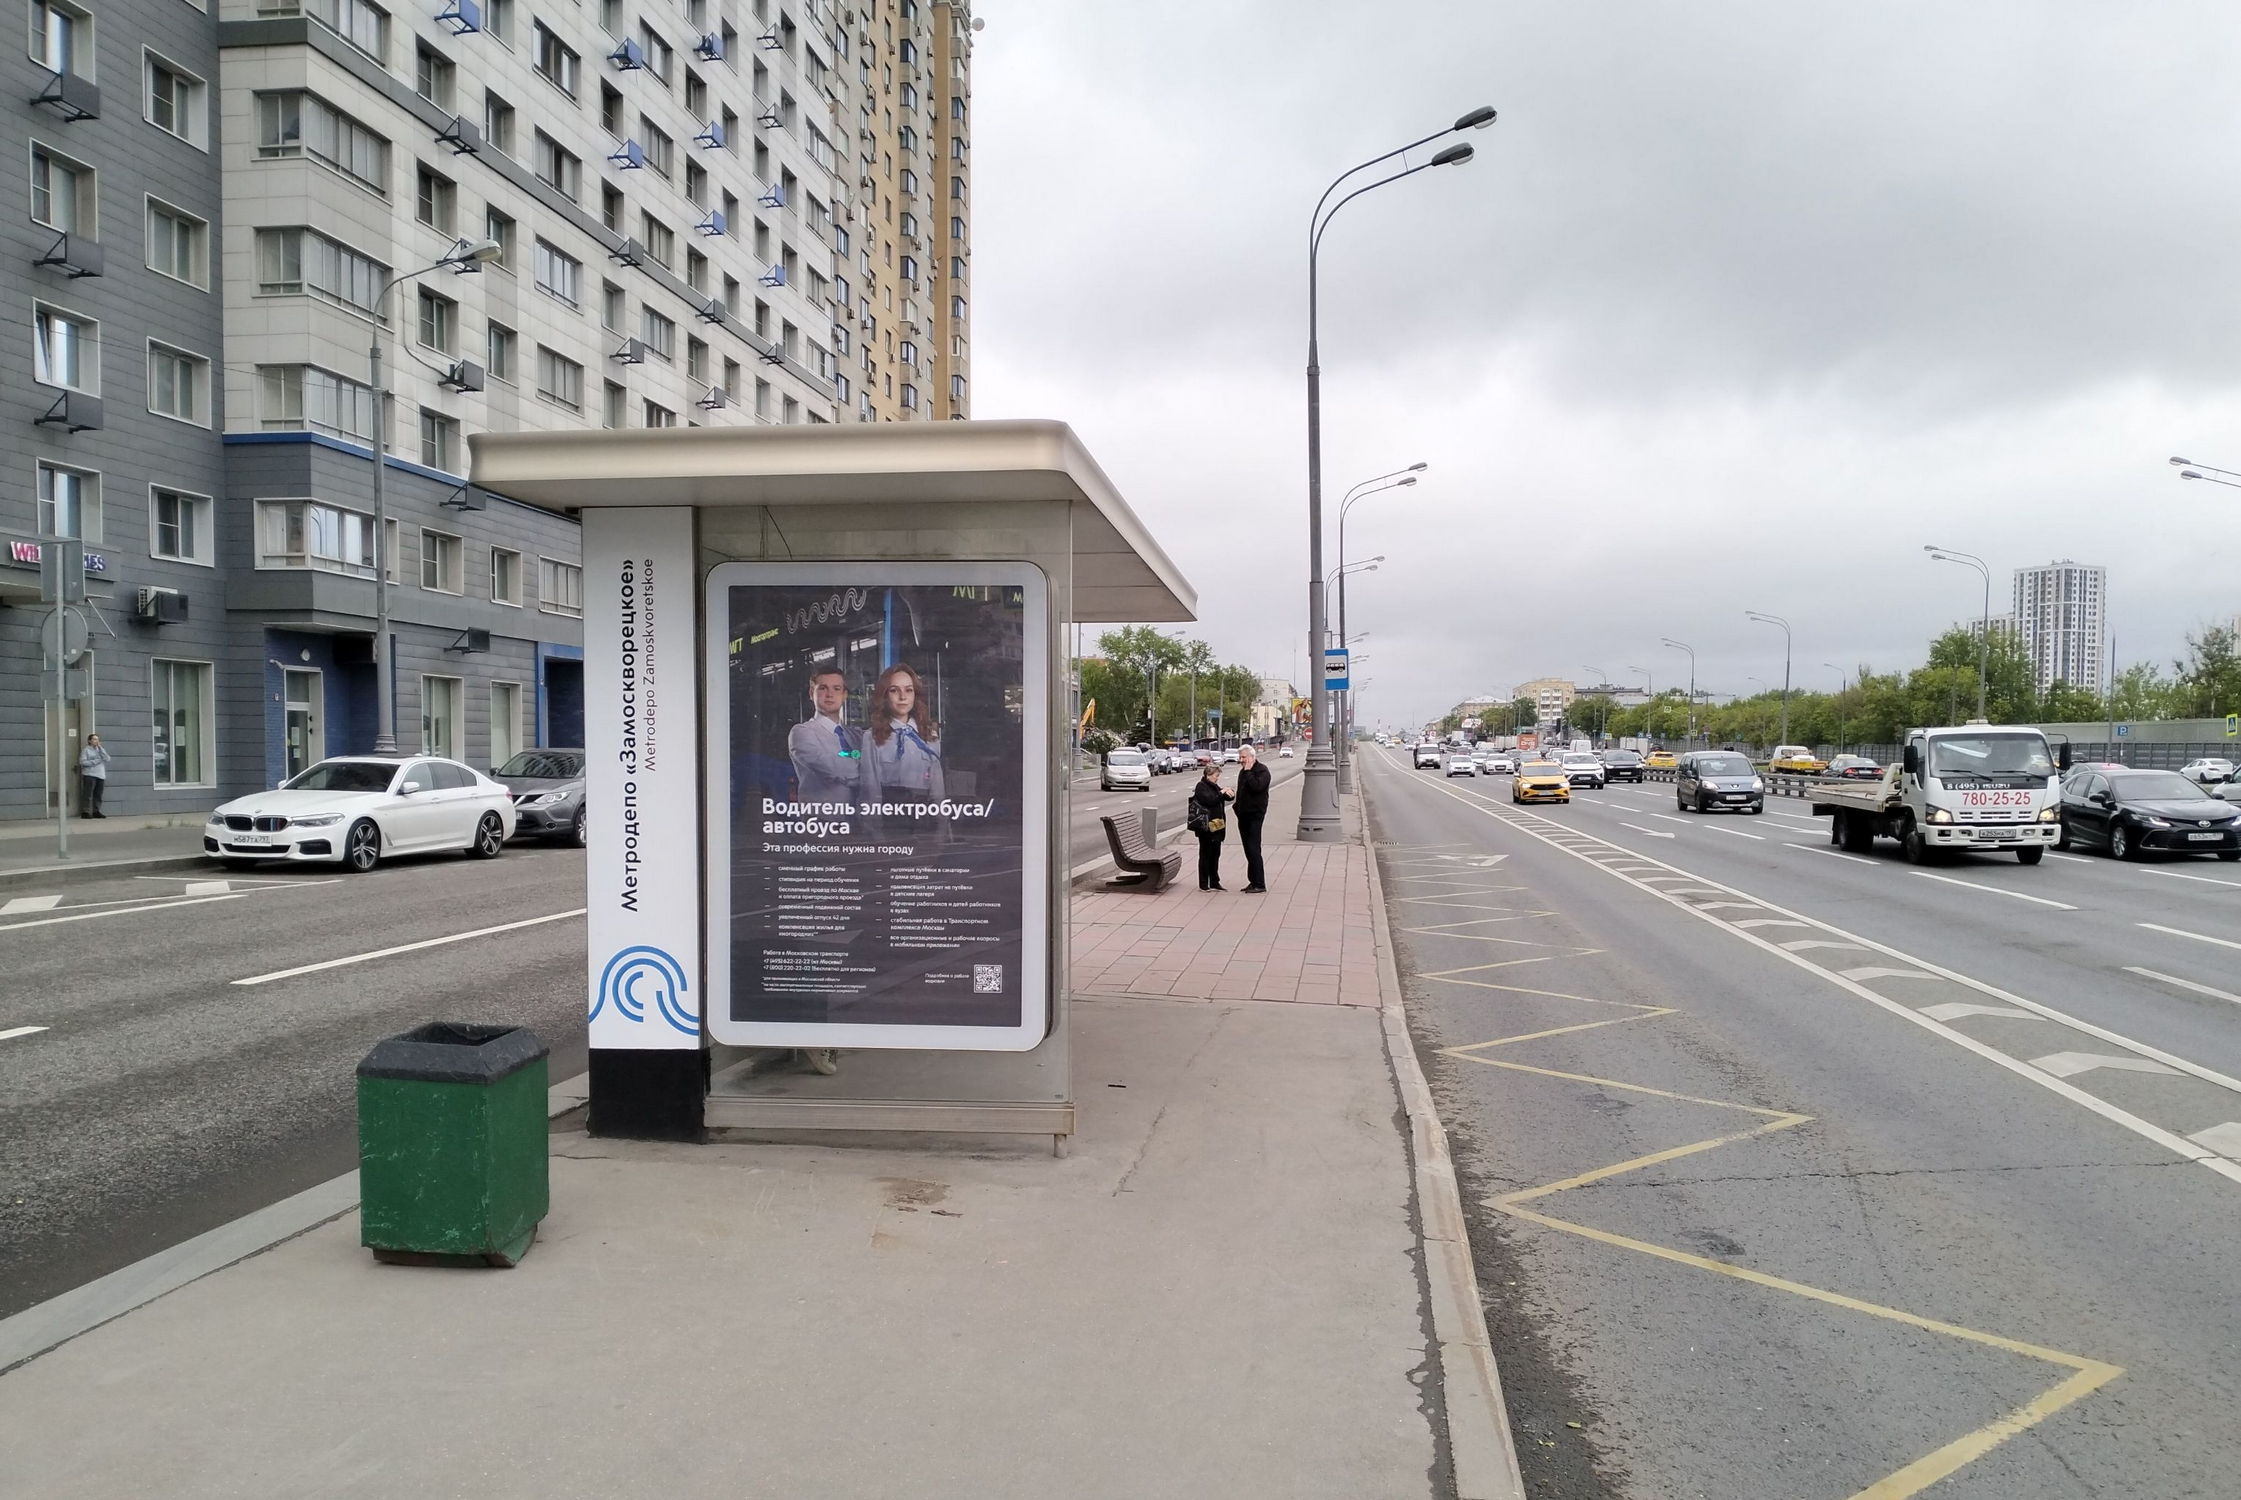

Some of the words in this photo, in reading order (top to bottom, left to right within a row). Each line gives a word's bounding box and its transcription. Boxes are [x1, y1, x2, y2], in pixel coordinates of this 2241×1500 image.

[641, 559, 656, 684] Zamoskvoretskoe
[620, 560, 638, 775] «Замоскворецкое»
[644, 690, 658, 771] Metrodepo
[762, 798, 855, 817] Водитель
[860, 798, 994, 820] электробуса/
[1962, 792, 2031, 806] 780-25-25
[621, 782, 641, 912] Метродепо
[762, 818, 850, 838] автобуса
[762, 843, 781, 852] Эта
[783, 843, 840, 854] профессия
[842, 846, 875, 854] нужна
[877, 846, 914, 855] городу
